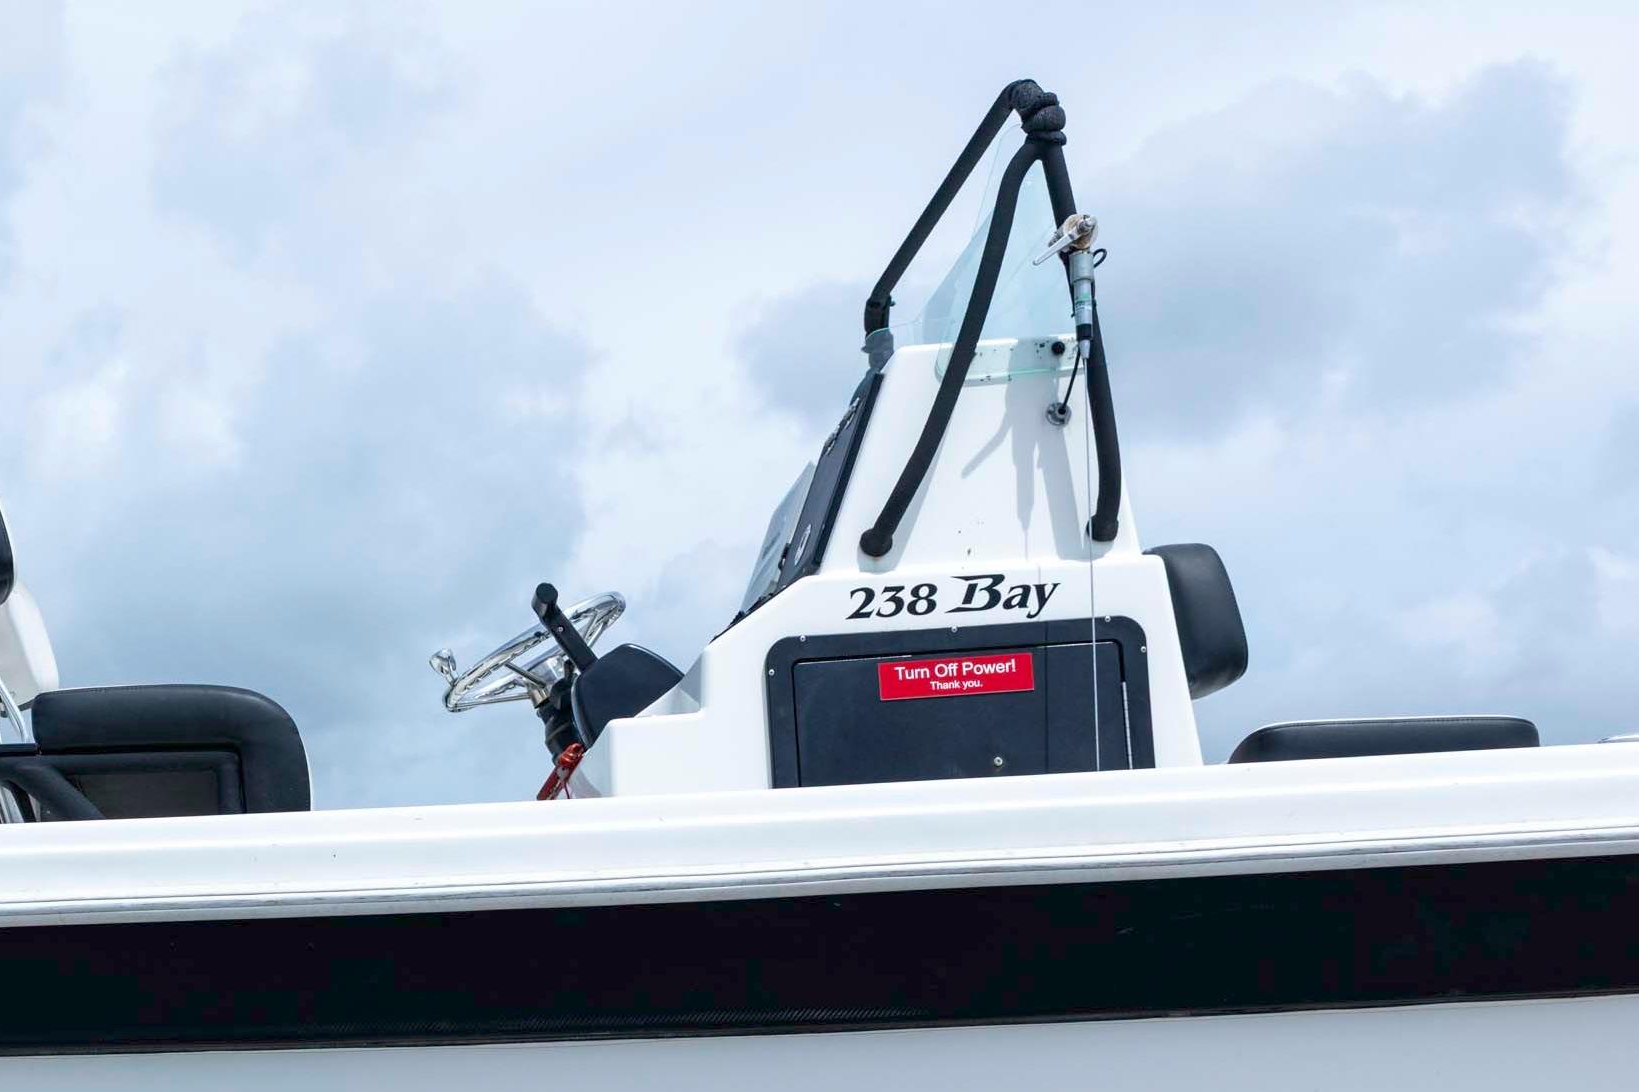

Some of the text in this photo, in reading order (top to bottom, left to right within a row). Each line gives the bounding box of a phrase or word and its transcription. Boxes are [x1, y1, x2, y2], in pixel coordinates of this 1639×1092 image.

[846, 573, 1061, 620] 238 Bay
[894, 658, 1017, 681] Turn Off Power!
[930, 680, 983, 692] Thank you.
